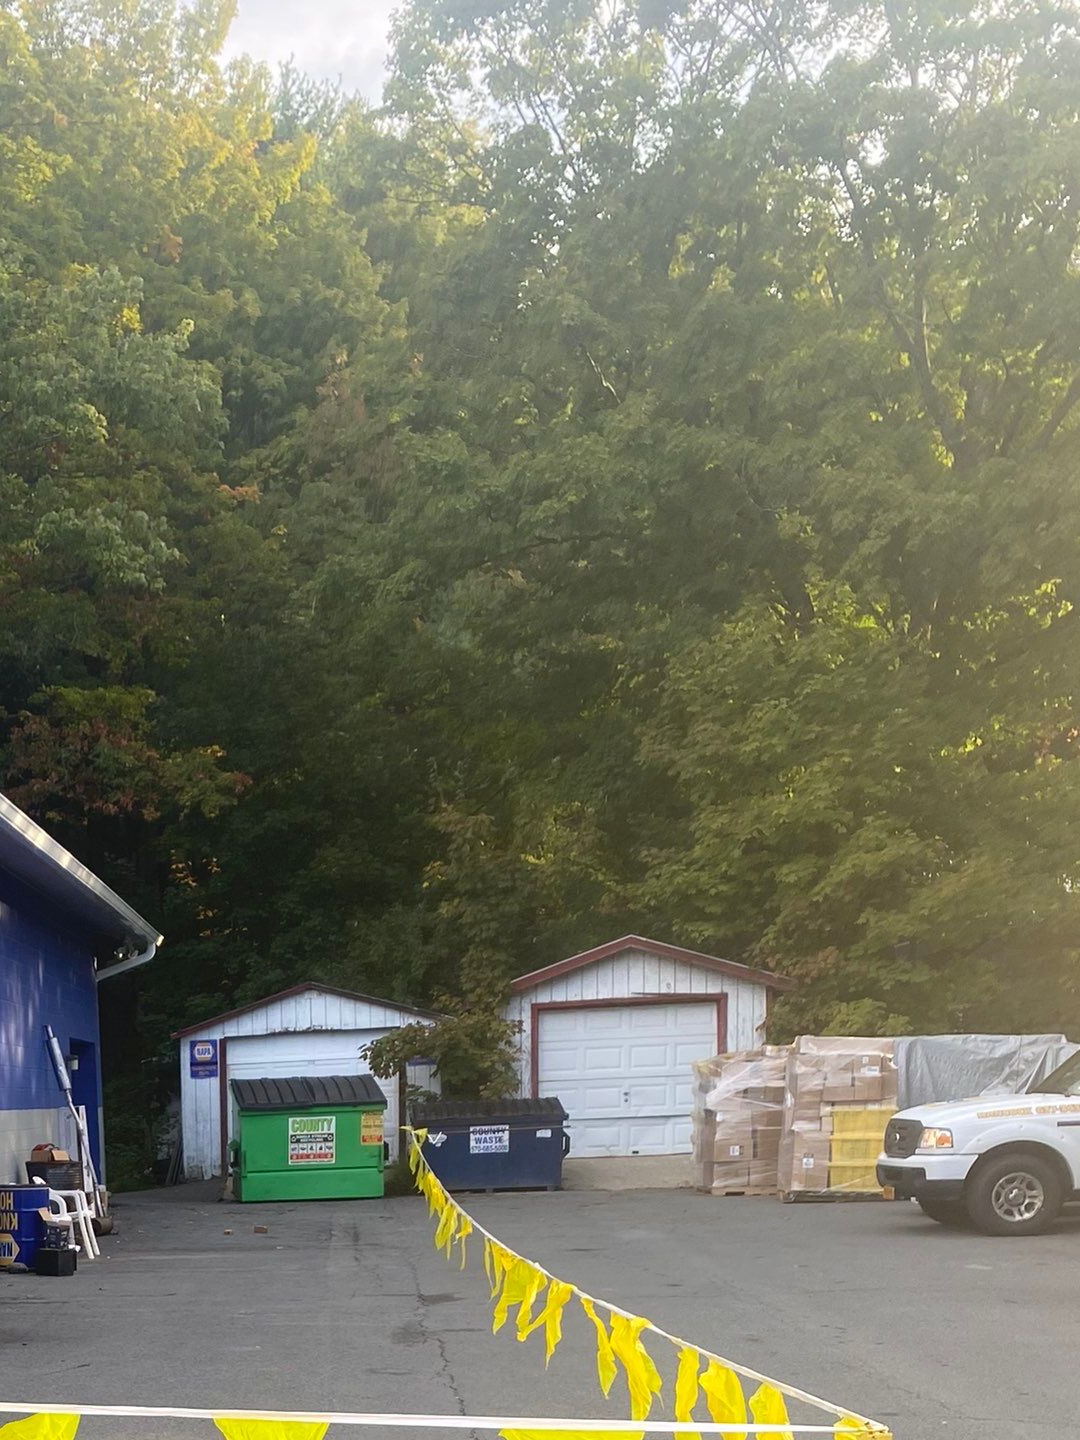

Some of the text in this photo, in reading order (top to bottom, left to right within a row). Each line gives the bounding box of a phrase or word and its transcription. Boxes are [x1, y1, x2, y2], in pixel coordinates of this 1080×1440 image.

[291, 1119, 333, 1133] COUNTY
[472, 1127, 506, 1136] COUNTY
[474, 1136, 504, 1145] WASTE
